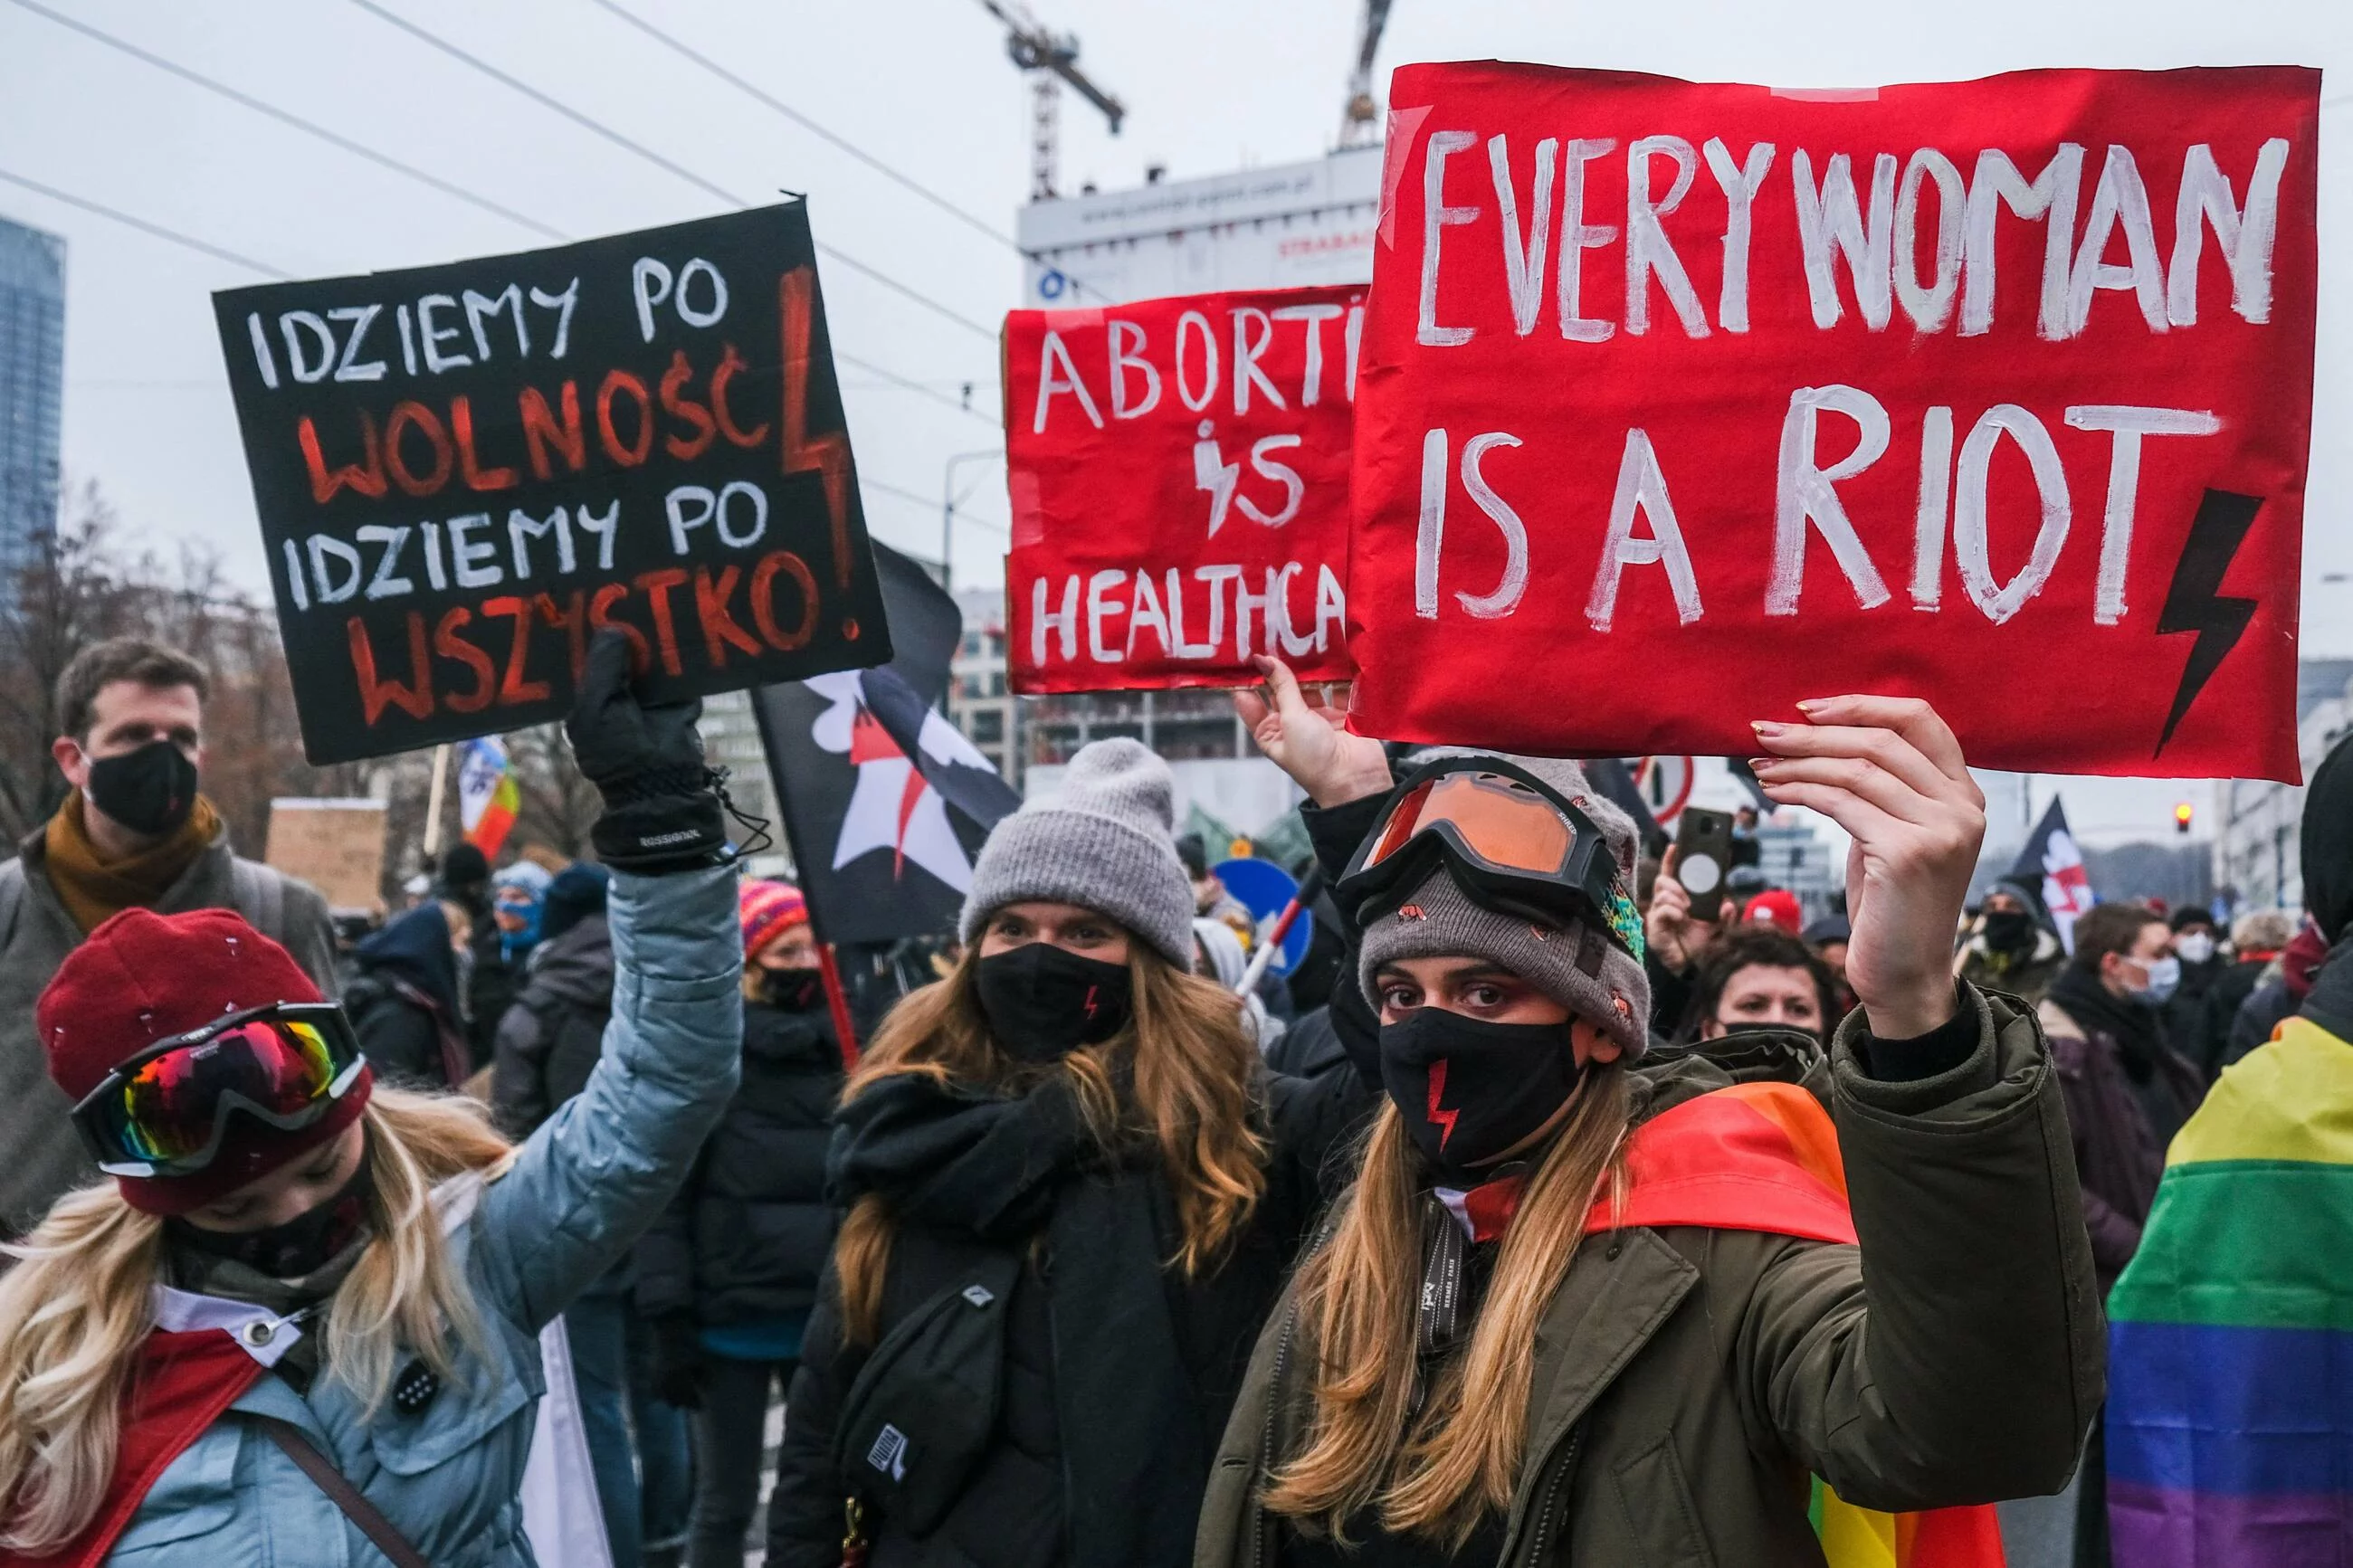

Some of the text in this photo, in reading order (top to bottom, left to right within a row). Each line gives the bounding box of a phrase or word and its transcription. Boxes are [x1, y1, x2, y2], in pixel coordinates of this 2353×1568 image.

[248, 257, 728, 389] IDZIEMY PO
[283, 480, 767, 611] IDZIEMY PO
[1415, 384, 2224, 632] IS A RIOT
[1031, 561, 1346, 668] HEALTHCA
[1557, 812, 1577, 834] SHRED
